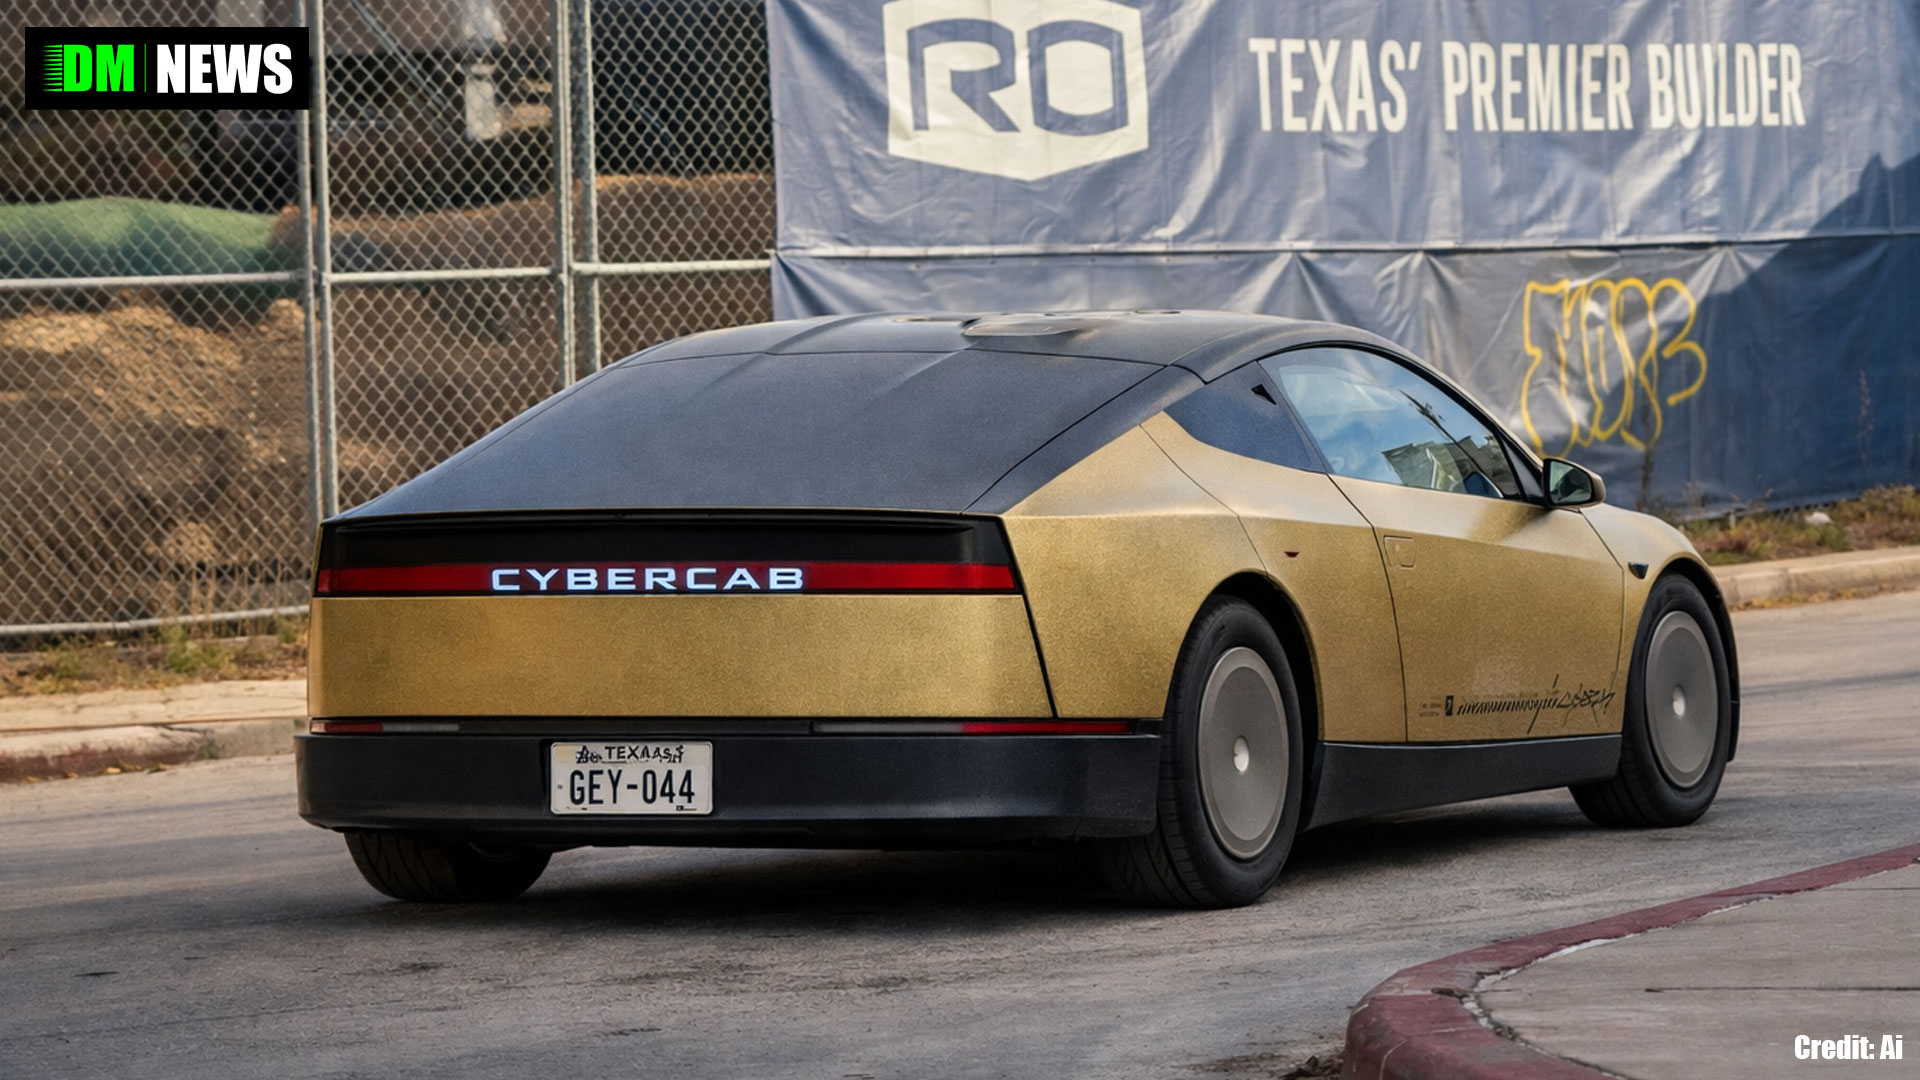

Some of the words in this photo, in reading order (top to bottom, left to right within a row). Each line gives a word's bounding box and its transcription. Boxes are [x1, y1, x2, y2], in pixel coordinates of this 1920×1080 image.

[1443, 40, 1633, 133] PREMIER
[1647, 42, 1807, 130] BUILDER
[490, 568, 804, 590] CYBERCAB
[569, 769, 695, 806] GEY-044
